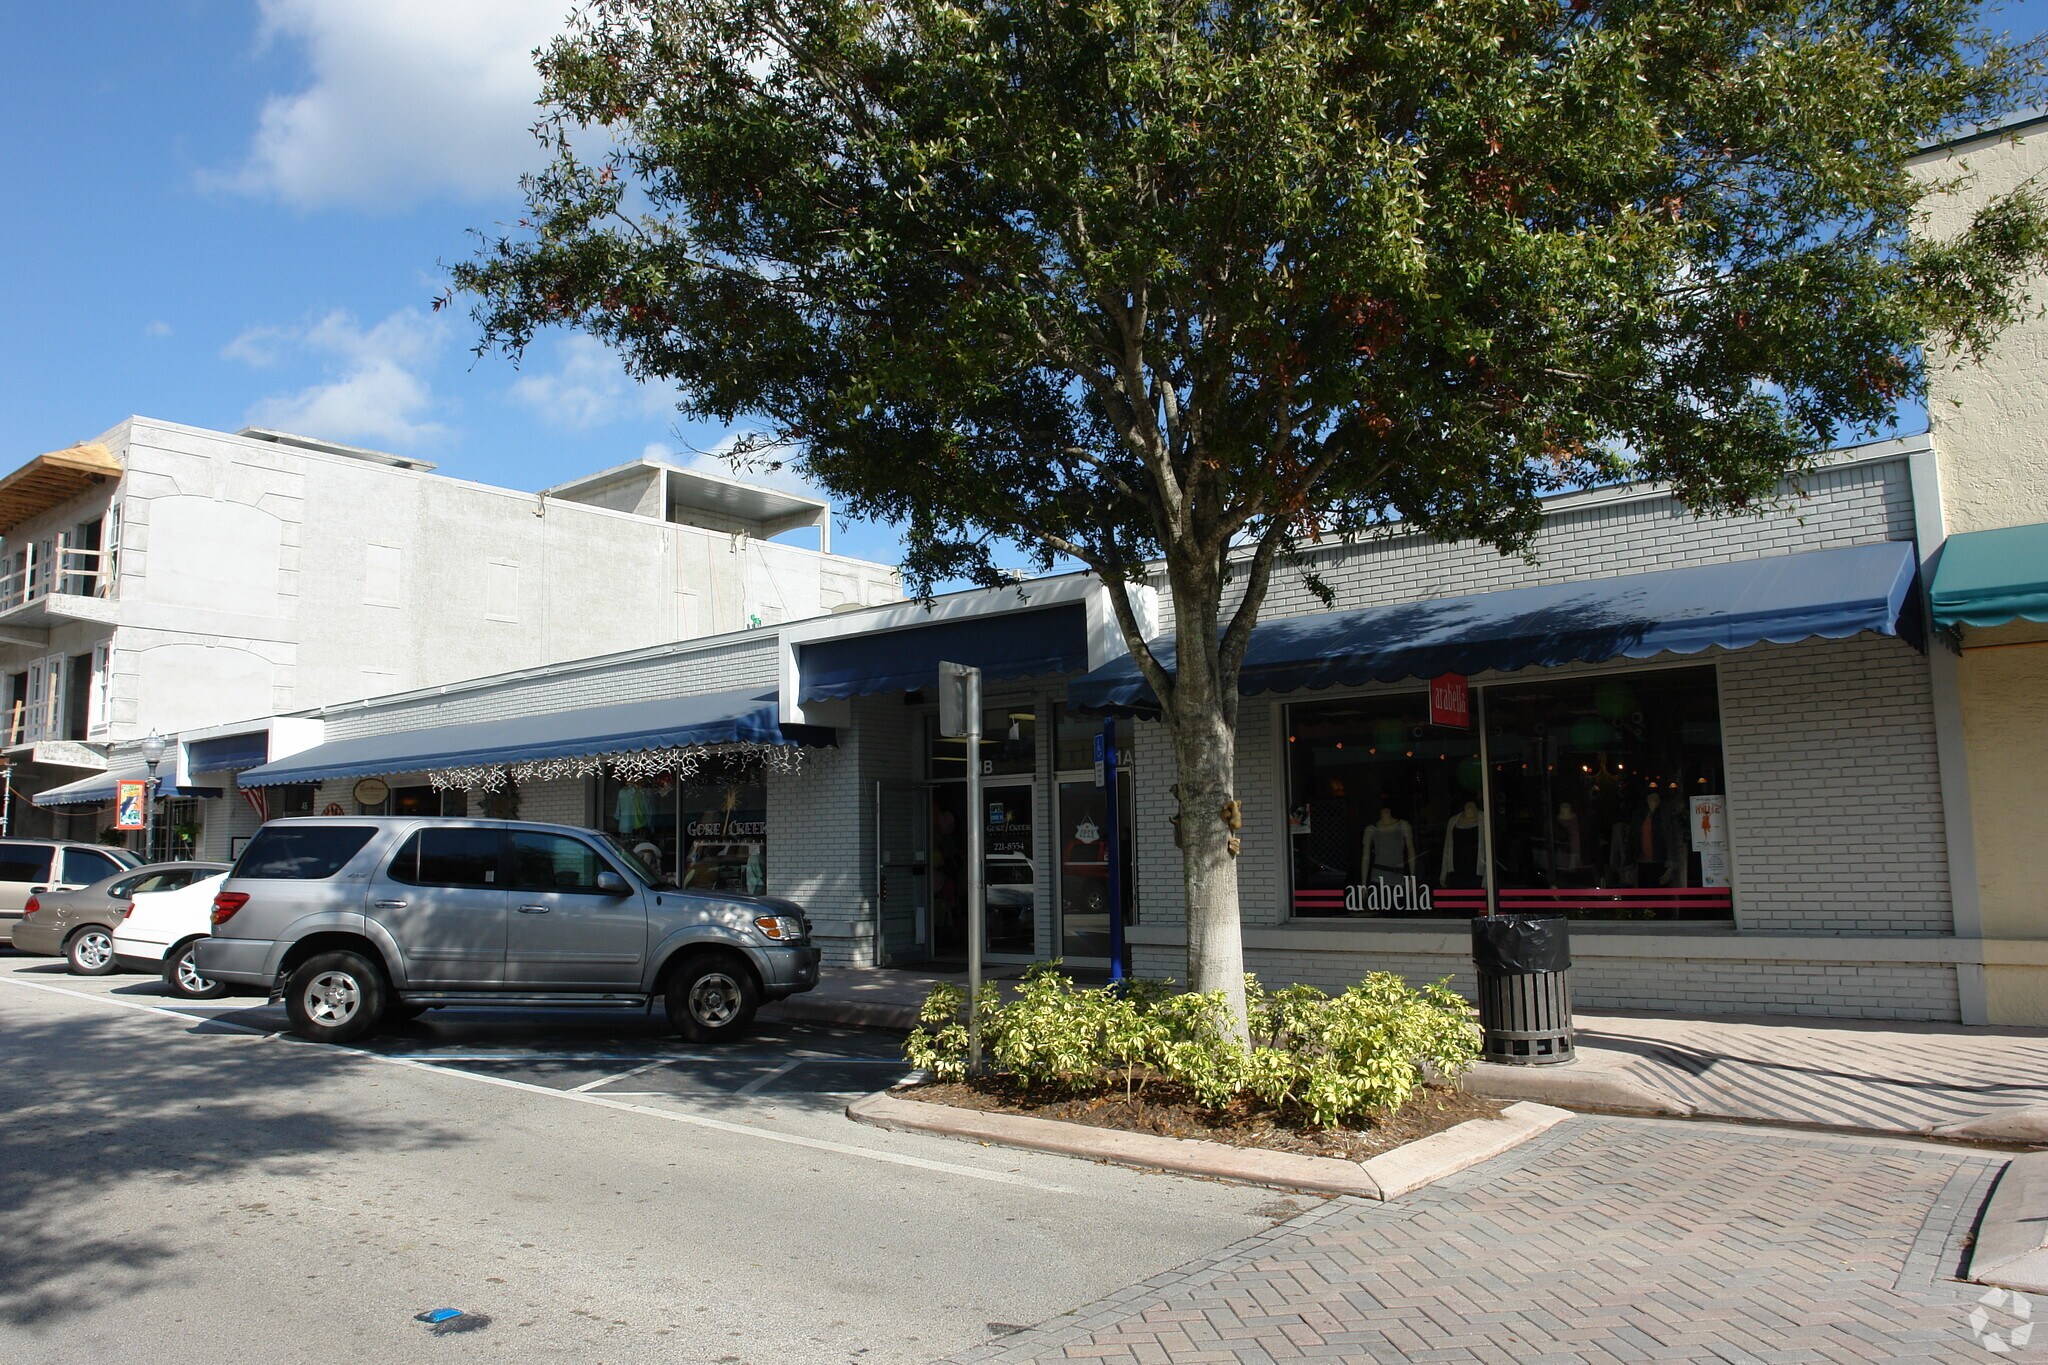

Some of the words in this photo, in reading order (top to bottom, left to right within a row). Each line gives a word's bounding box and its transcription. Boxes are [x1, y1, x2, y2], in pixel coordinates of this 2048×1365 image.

[1435, 683, 1466, 713] arabella
[687, 821, 720, 836] GORE
[1080, 829, 1095, 839] OPEN
[993, 842, 1024, 851] 221-8554
[1345, 876, 1432, 911] arabella
